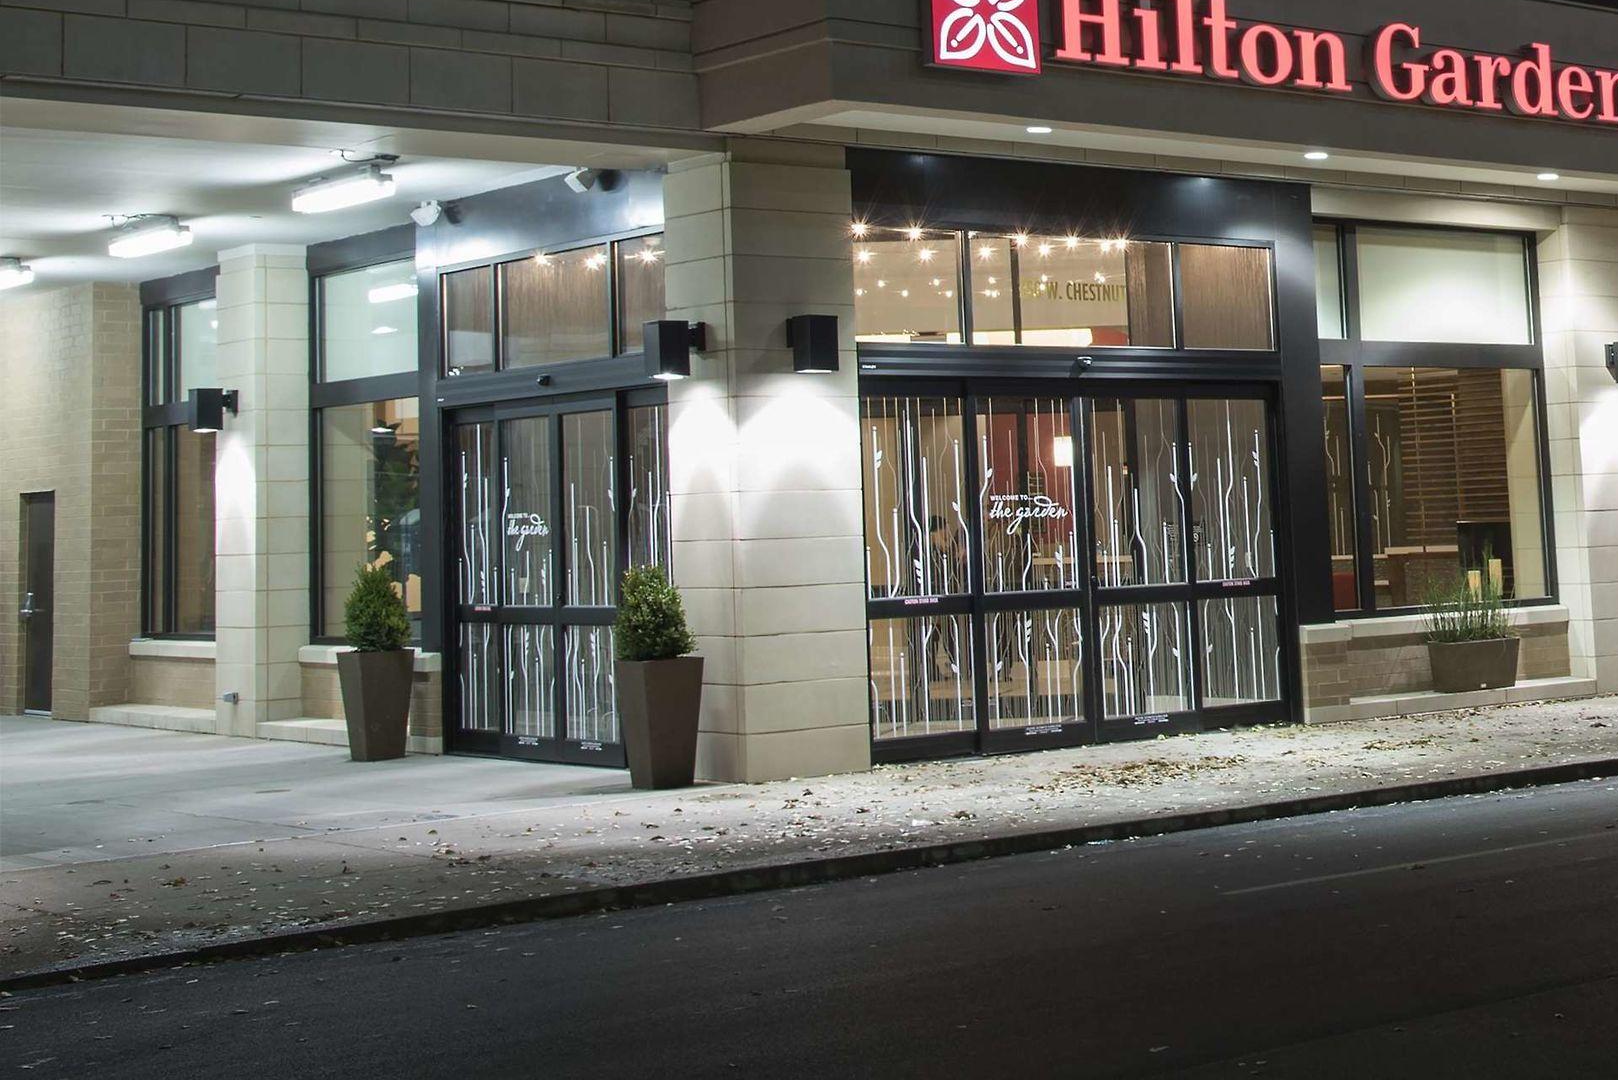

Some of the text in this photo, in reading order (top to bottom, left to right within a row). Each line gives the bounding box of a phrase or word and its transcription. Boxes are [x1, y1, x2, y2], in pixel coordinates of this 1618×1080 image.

[1065, 281, 1126, 302] CHESTNUT
[989, 495, 1068, 535] the garden
